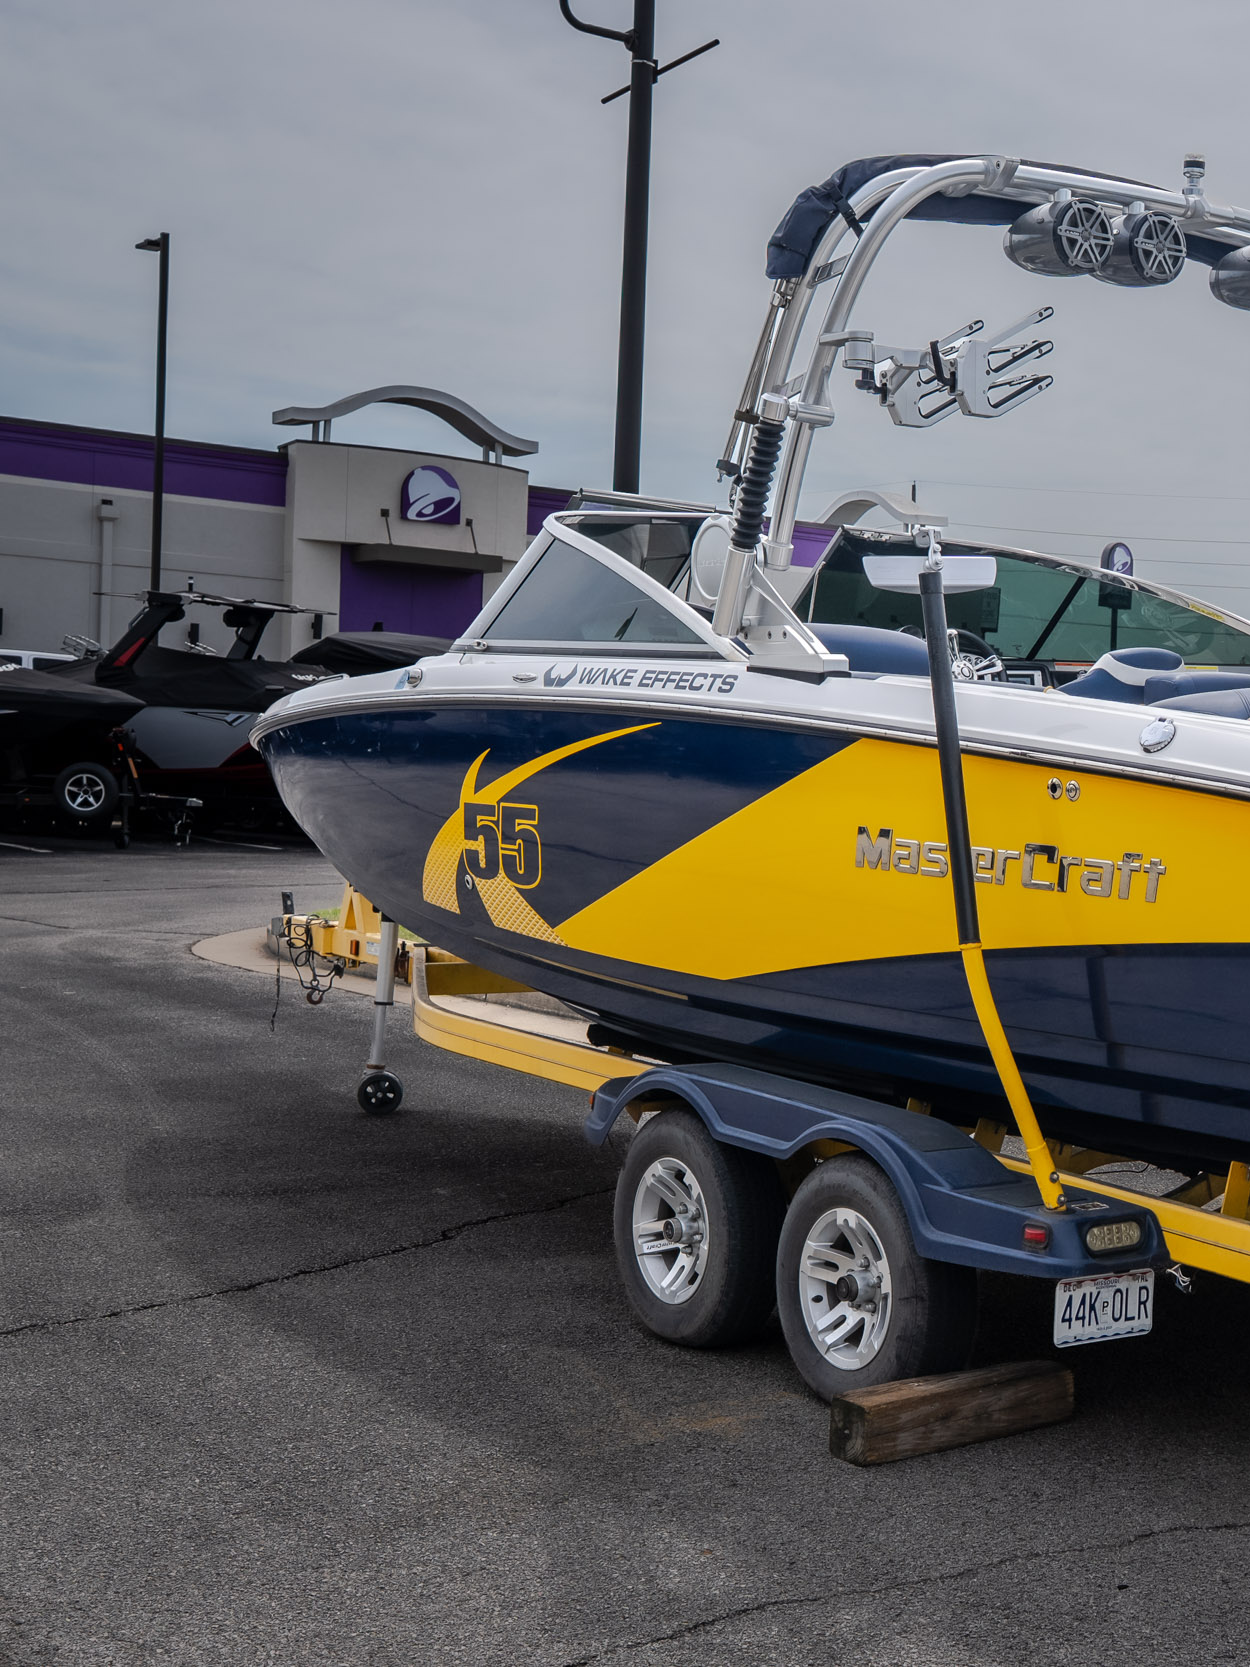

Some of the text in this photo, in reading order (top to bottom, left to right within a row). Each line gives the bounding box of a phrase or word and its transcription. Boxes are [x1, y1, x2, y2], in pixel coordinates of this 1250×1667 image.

[578, 667, 739, 694] WAKE EFFECTS
[463, 801, 542, 889] 55
[855, 825, 1166, 903] MaserCraft
[1093, 1279, 1120, 1287] MISSOURI
[1061, 1291, 1101, 1330] 44K
